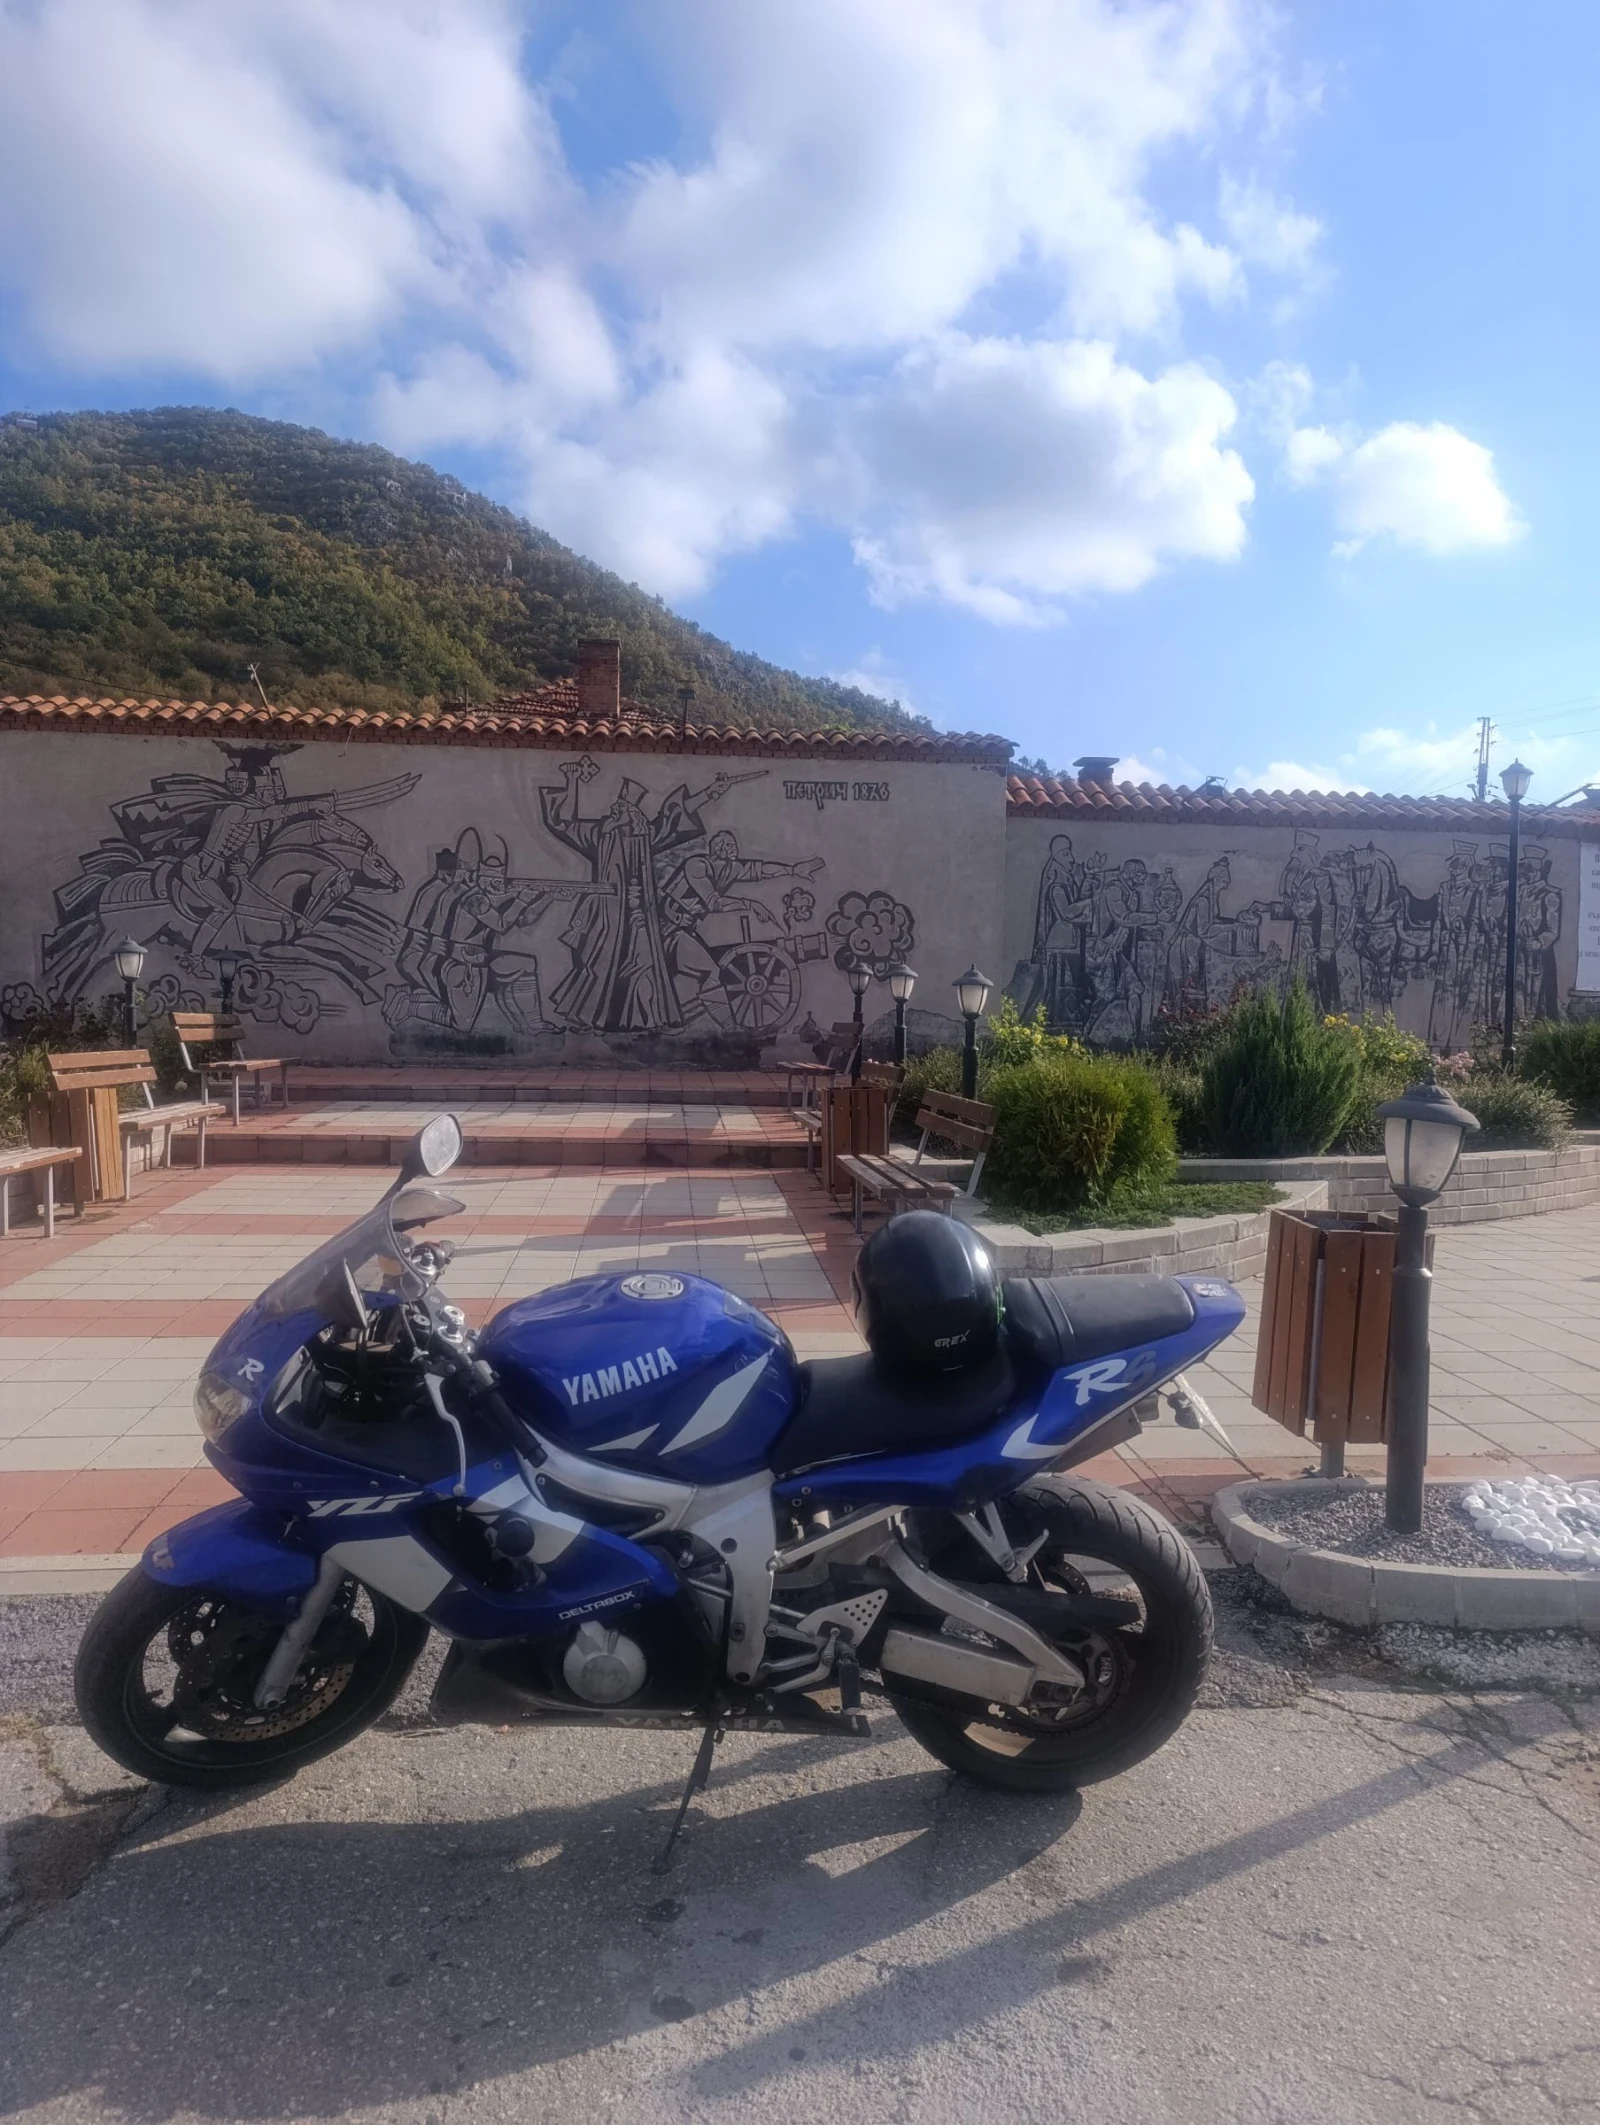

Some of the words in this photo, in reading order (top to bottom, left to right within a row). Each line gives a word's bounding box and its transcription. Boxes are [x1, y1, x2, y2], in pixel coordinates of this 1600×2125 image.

[852, 782, 890, 801] 1876
[934, 1329, 970, 1348] GREX
[237, 1357, 264, 1382] R
[562, 1346, 678, 1406] YAMAHA
[1063, 1351, 1156, 1406] R6
[558, 1590, 635, 1620] DELTABOX
